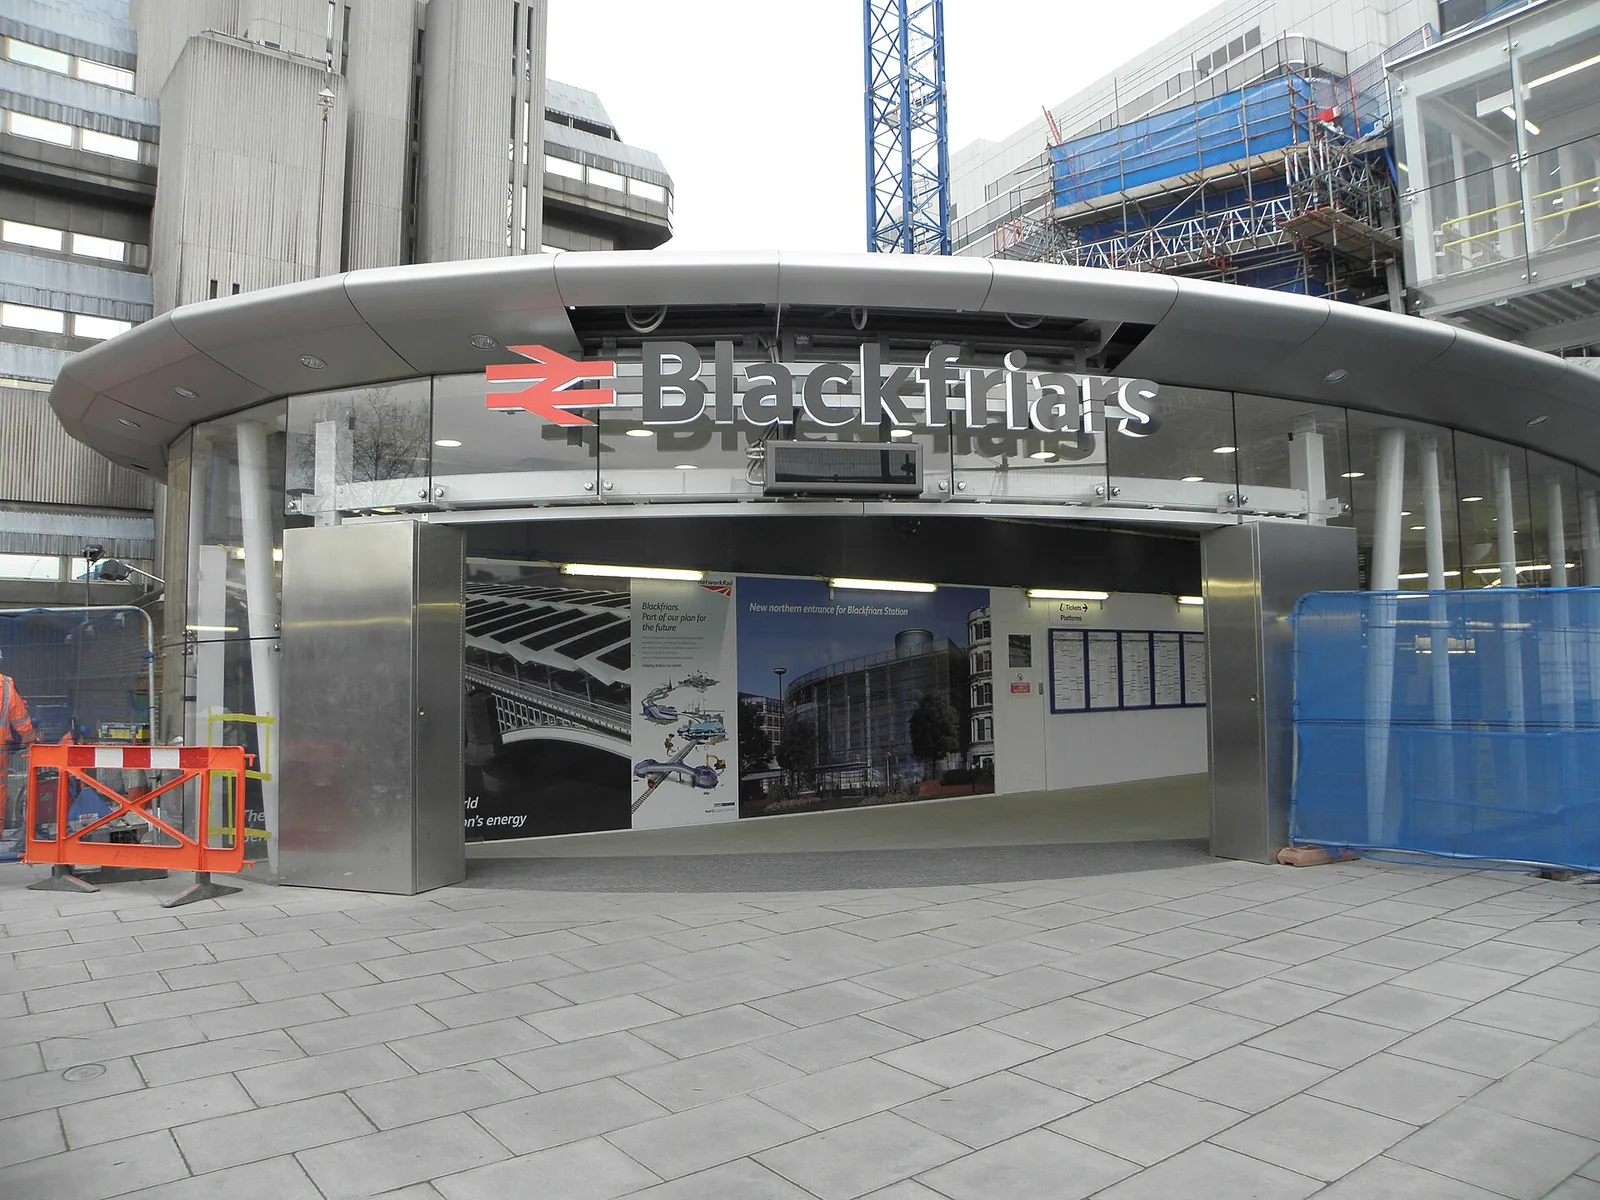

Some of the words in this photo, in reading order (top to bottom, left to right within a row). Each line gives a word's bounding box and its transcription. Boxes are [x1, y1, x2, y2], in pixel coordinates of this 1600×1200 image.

[641, 341, 1160, 438] Blackfriars
[641, 602, 679, 611] Blackfriars.
[749, 603, 767, 612] New
[768, 604, 802, 613] northern
[803, 605, 835, 614] entrance
[836, 605, 847, 615] for
[847, 605, 883, 616] Blackfriars
[884, 606, 909, 616] Station
[641, 612, 657, 621] Part
[658, 613, 667, 622] of
[680, 613, 696, 623] plan
[697, 613, 707, 623] for
[642, 623, 654, 631] the
[655, 622, 677, 632] future
[486, 814, 528, 828] energy
